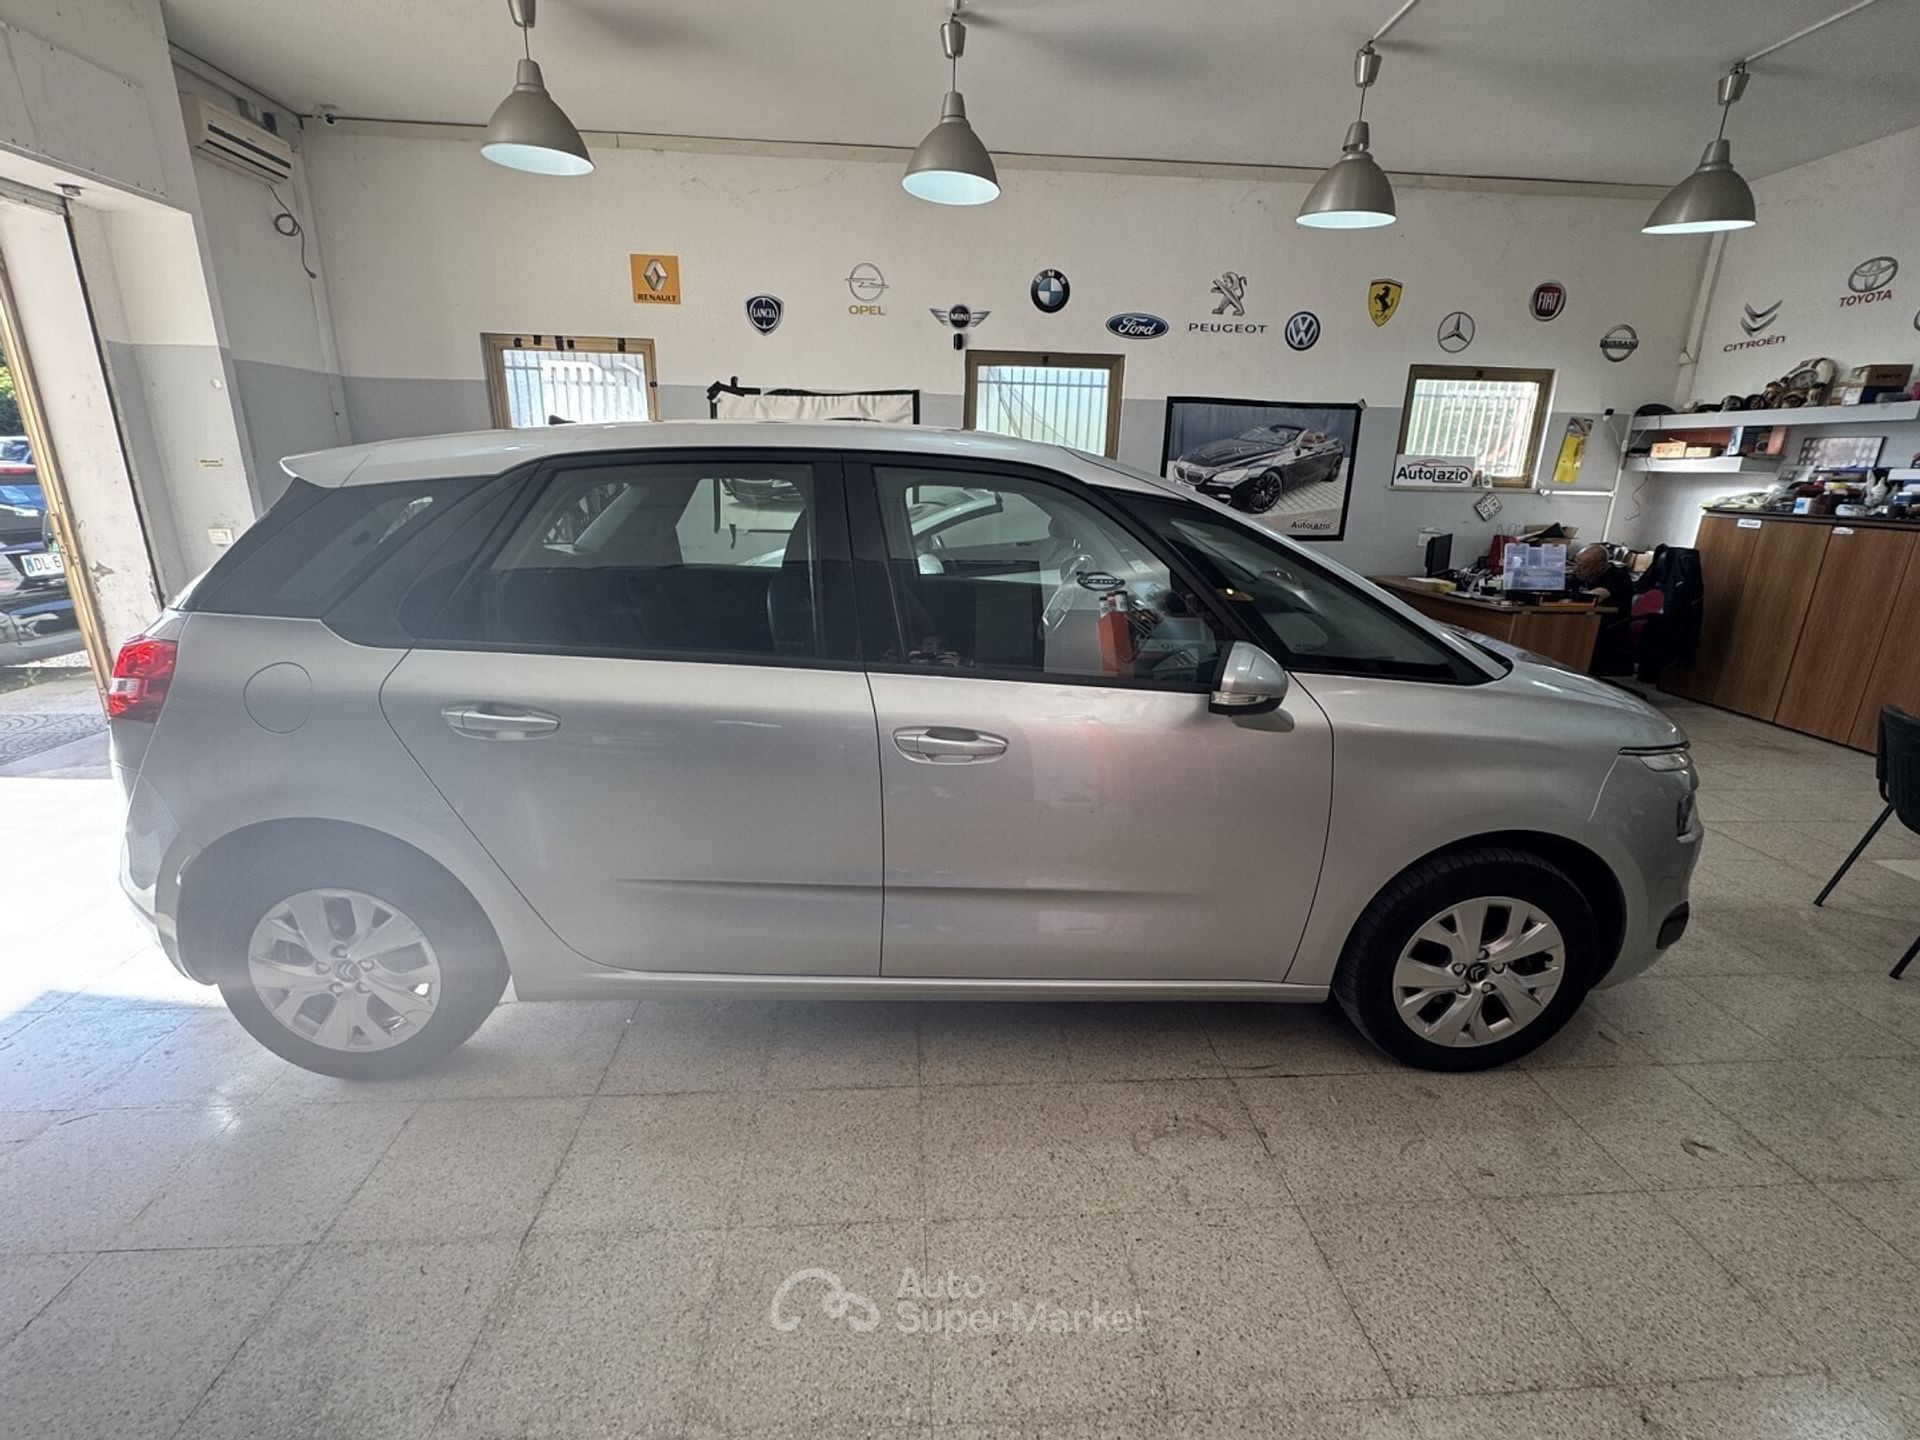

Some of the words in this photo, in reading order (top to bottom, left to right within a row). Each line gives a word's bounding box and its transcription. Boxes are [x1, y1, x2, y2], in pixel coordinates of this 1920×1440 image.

[637, 293, 677, 302] RENAULT
[1537, 291, 1561, 311] FIAT
[1839, 289, 1892, 307] TOYOTA
[753, 307, 776, 319] LANCIA
[848, 304, 886, 316] OPEL
[951, 312, 970, 322] MINI
[1118, 317, 1157, 335] Ford
[1189, 322, 1268, 334] PEUGEOT
